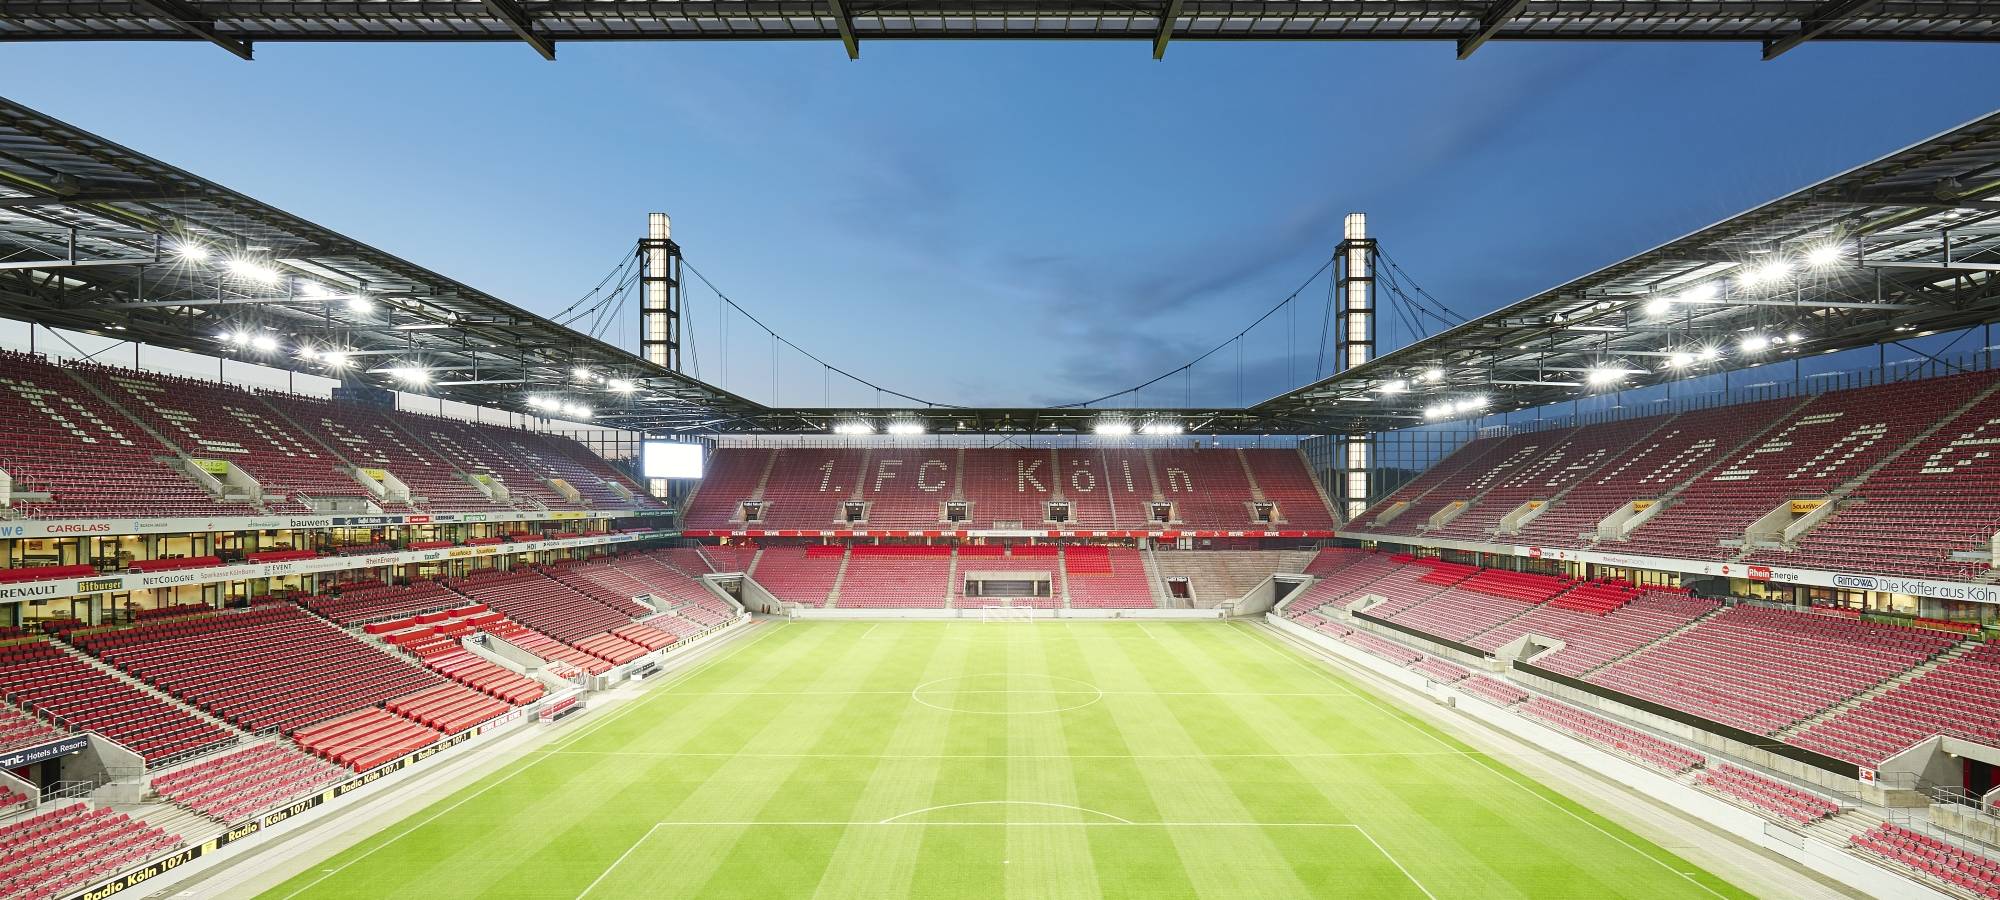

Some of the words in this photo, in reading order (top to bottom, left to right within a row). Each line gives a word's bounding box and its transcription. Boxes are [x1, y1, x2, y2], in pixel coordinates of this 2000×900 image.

[818, 459, 844, 492] 1.
[874, 458, 948, 492] FC
[1017, 458, 1194, 493] Köln
[47, 523, 110, 533] CARGLASS
[290, 518, 329, 528] bauwens
[272, 563, 292, 571] EVENT
[1749, 568, 1799, 582] RheinEnergie
[79, 580, 121, 592] Bitburger
[1838, 576, 1873, 589] RIMOWA
[0, 585, 57, 598] RENAULT
[1880, 579, 1898, 592] Die
[1901, 580, 1937, 596] Koffer
[1940, 587, 1964, 599] aus
[1968, 585, 1997, 602] Köln
[27, 749, 50, 761] Hotels
[52, 746, 58, 754] &
[60, 740, 87, 753] Resorts
[341, 780, 362, 793] Radio
[364, 772, 380, 784] Köln
[228, 823, 258, 842] Radio
[266, 811, 287, 827] Köln
[290, 799, 313, 816] 107,1
[127, 867, 157, 887] Köln
[161, 850, 192, 872] 107,1
